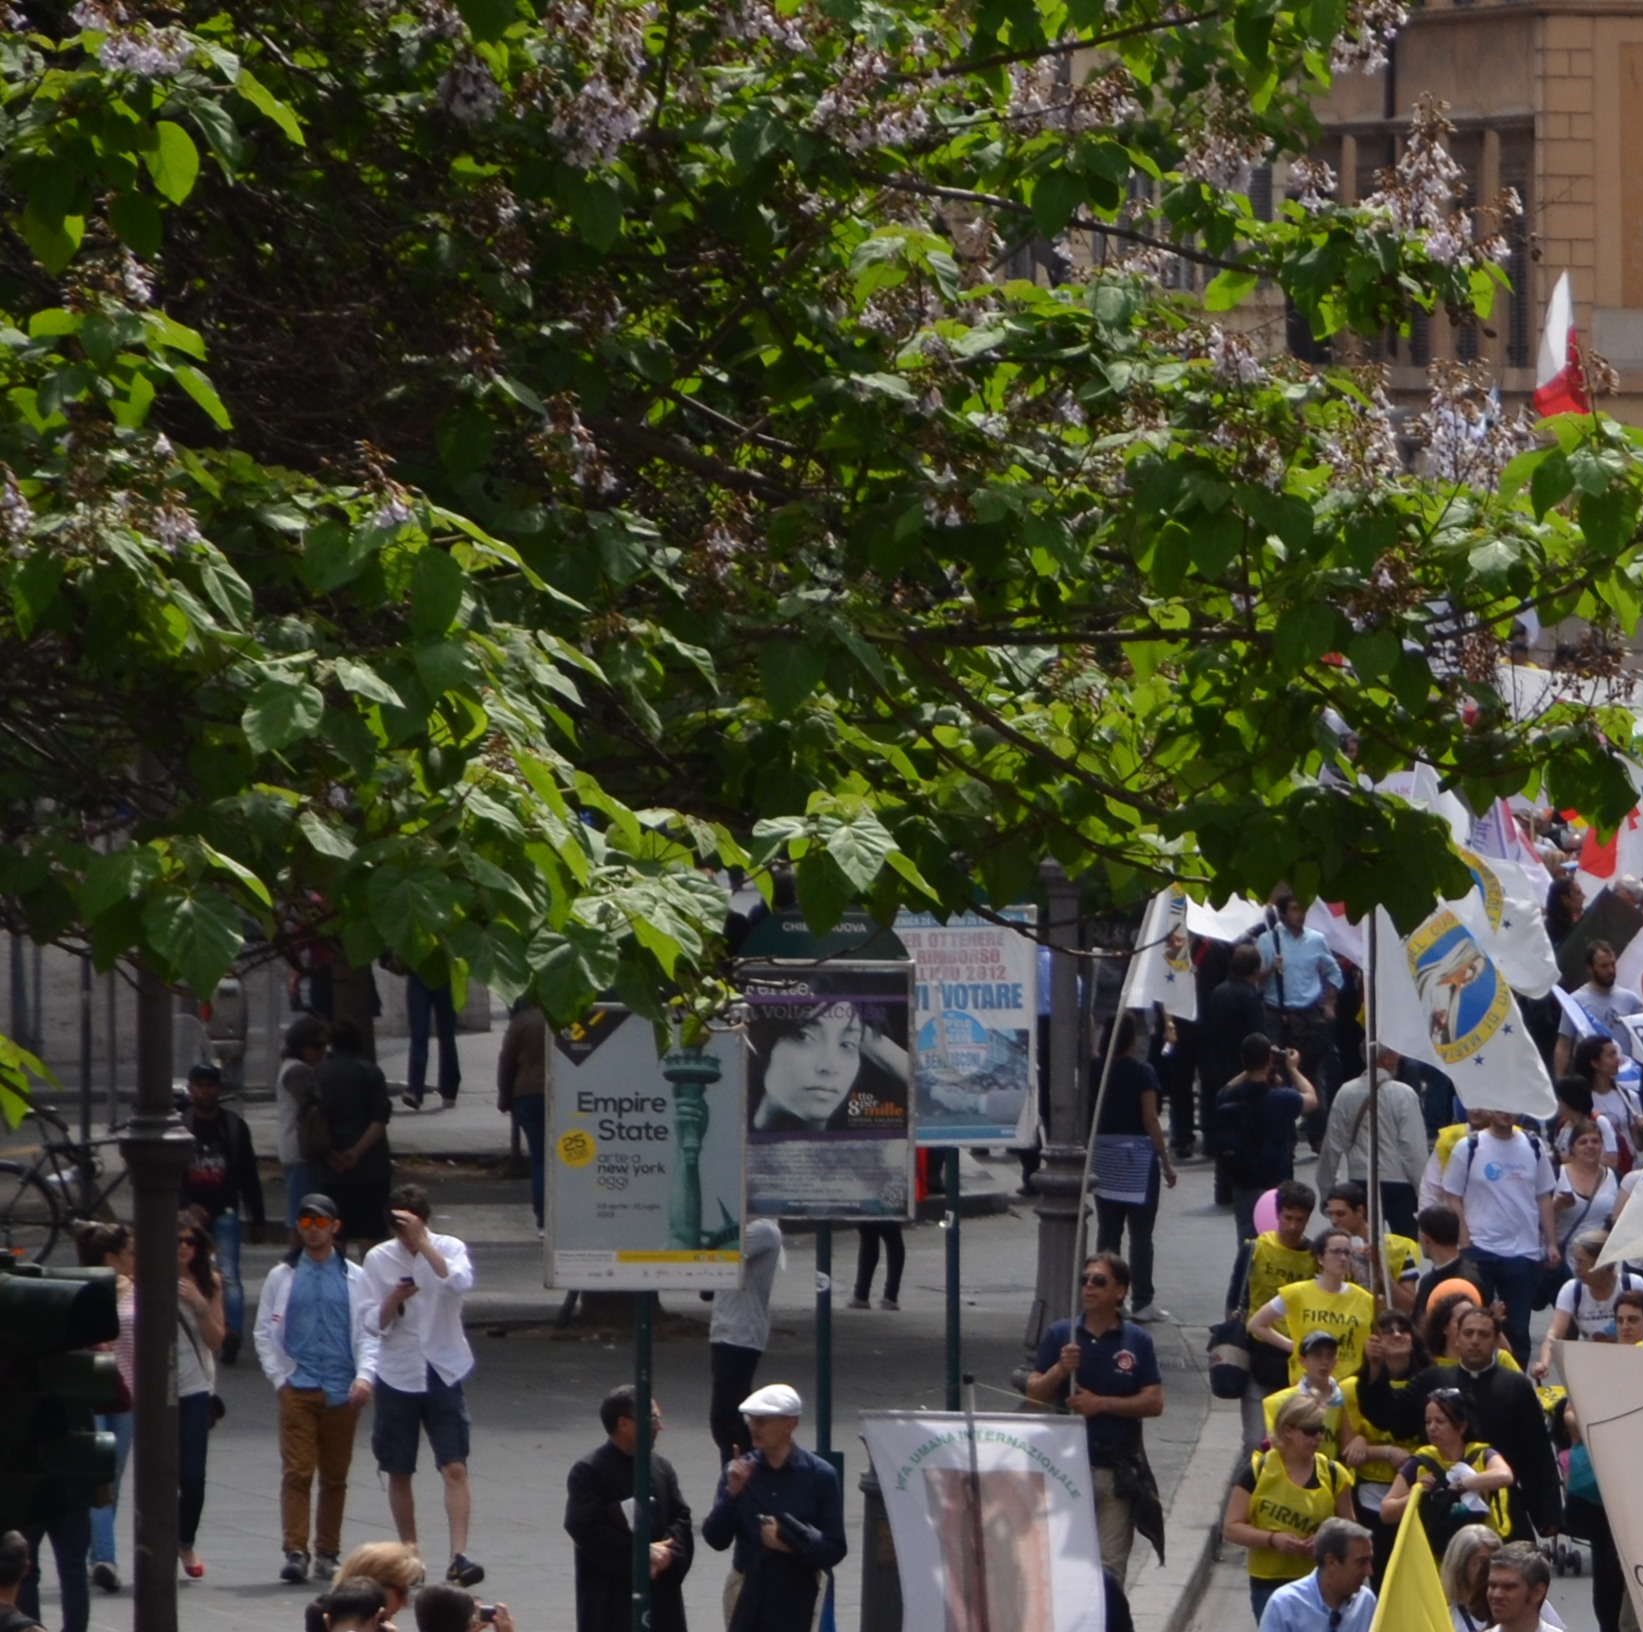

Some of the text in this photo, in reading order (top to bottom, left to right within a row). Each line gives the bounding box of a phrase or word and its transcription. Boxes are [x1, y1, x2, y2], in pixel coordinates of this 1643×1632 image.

[966, 965, 1007, 980] 2012
[940, 982, 1023, 1009] VOTARE
[577, 1091, 668, 1118] Empire
[864, 1103, 904, 1117] mille
[598, 1120, 669, 1142] State
[563, 1133, 587, 1152] 25
[597, 1162, 667, 1176] new york
[597, 1176, 630, 1190] oggi
[1302, 1309, 1360, 1327] FIRMA
[909, 1429, 956, 1465] UMANA
